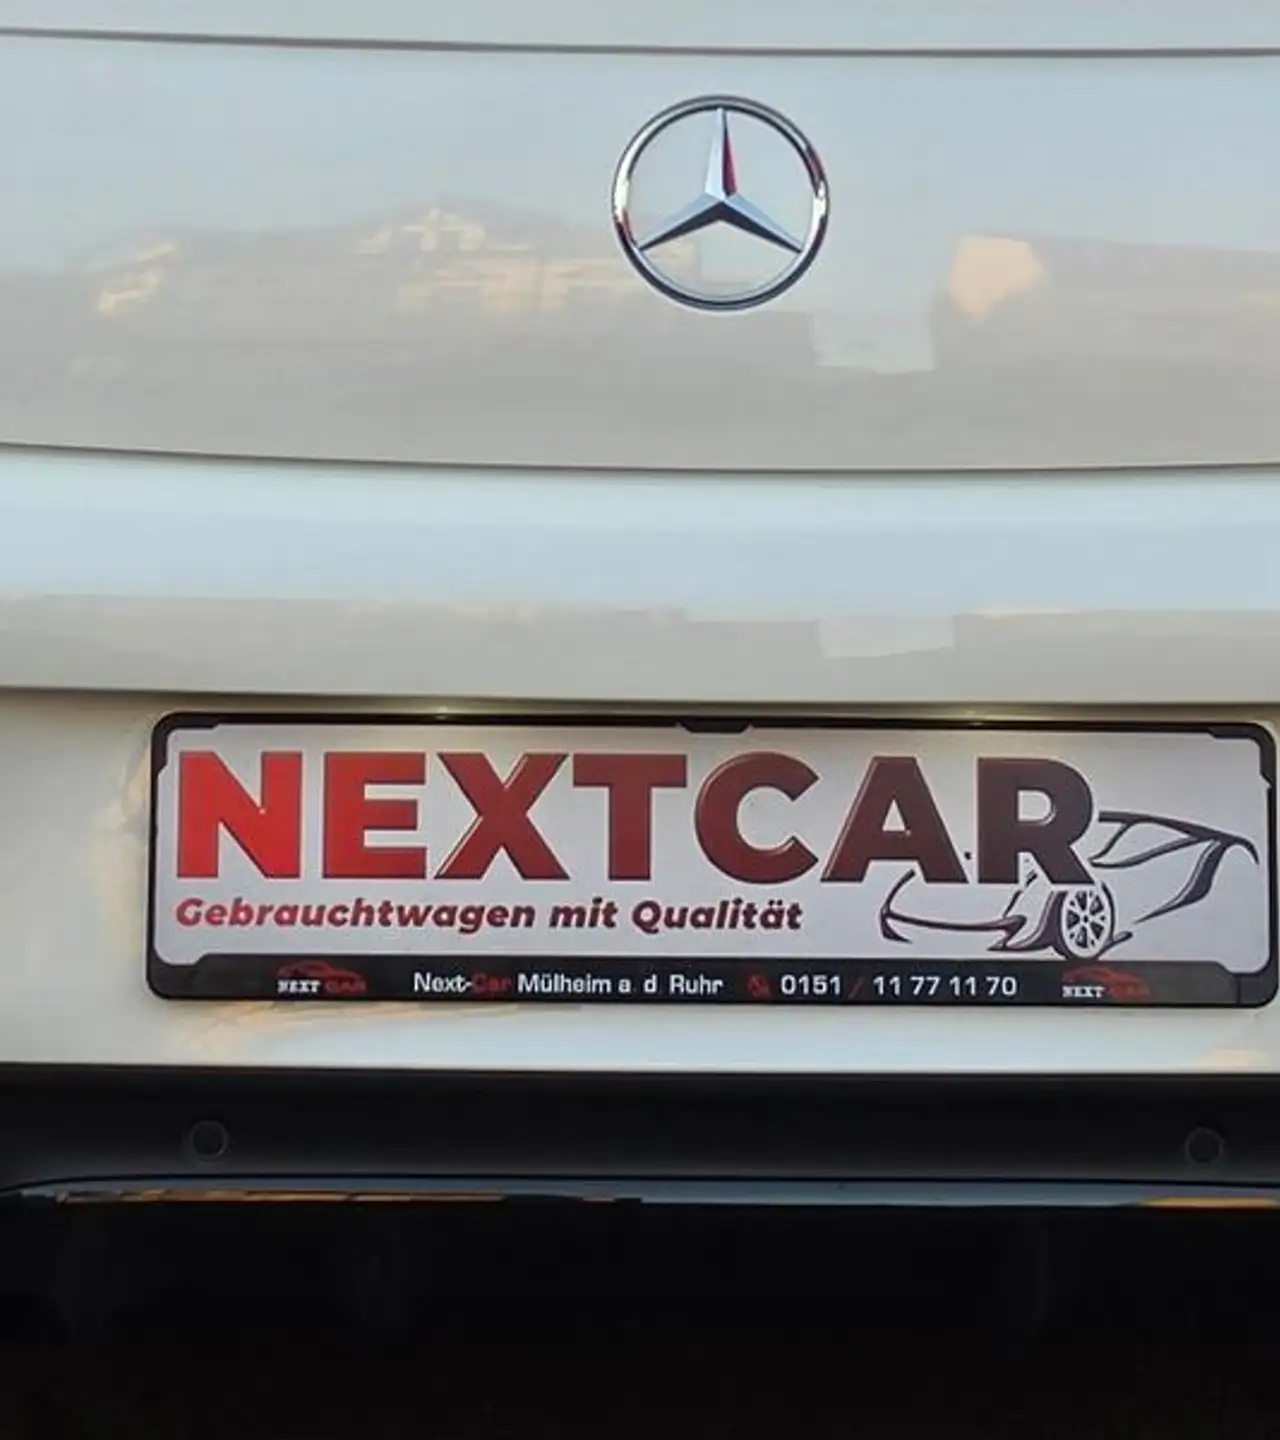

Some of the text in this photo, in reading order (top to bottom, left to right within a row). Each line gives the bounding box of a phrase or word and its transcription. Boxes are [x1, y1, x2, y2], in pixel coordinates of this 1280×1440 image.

[176, 750, 1096, 886] NEXTCAR
[176, 895, 804, 936] Gebrauchtwagen mit Qualität
[276, 978, 321, 994] NEXT
[517, 972, 613, 994] Mülheim
[669, 973, 724, 995] Ruhr
[780, 974, 841, 996] 0151
[872, 975, 901, 996] 11
[910, 975, 941, 997] 77
[949, 976, 977, 997] 11
[986, 976, 1018, 997] 70
[1061, 985, 1105, 999] NEXT
